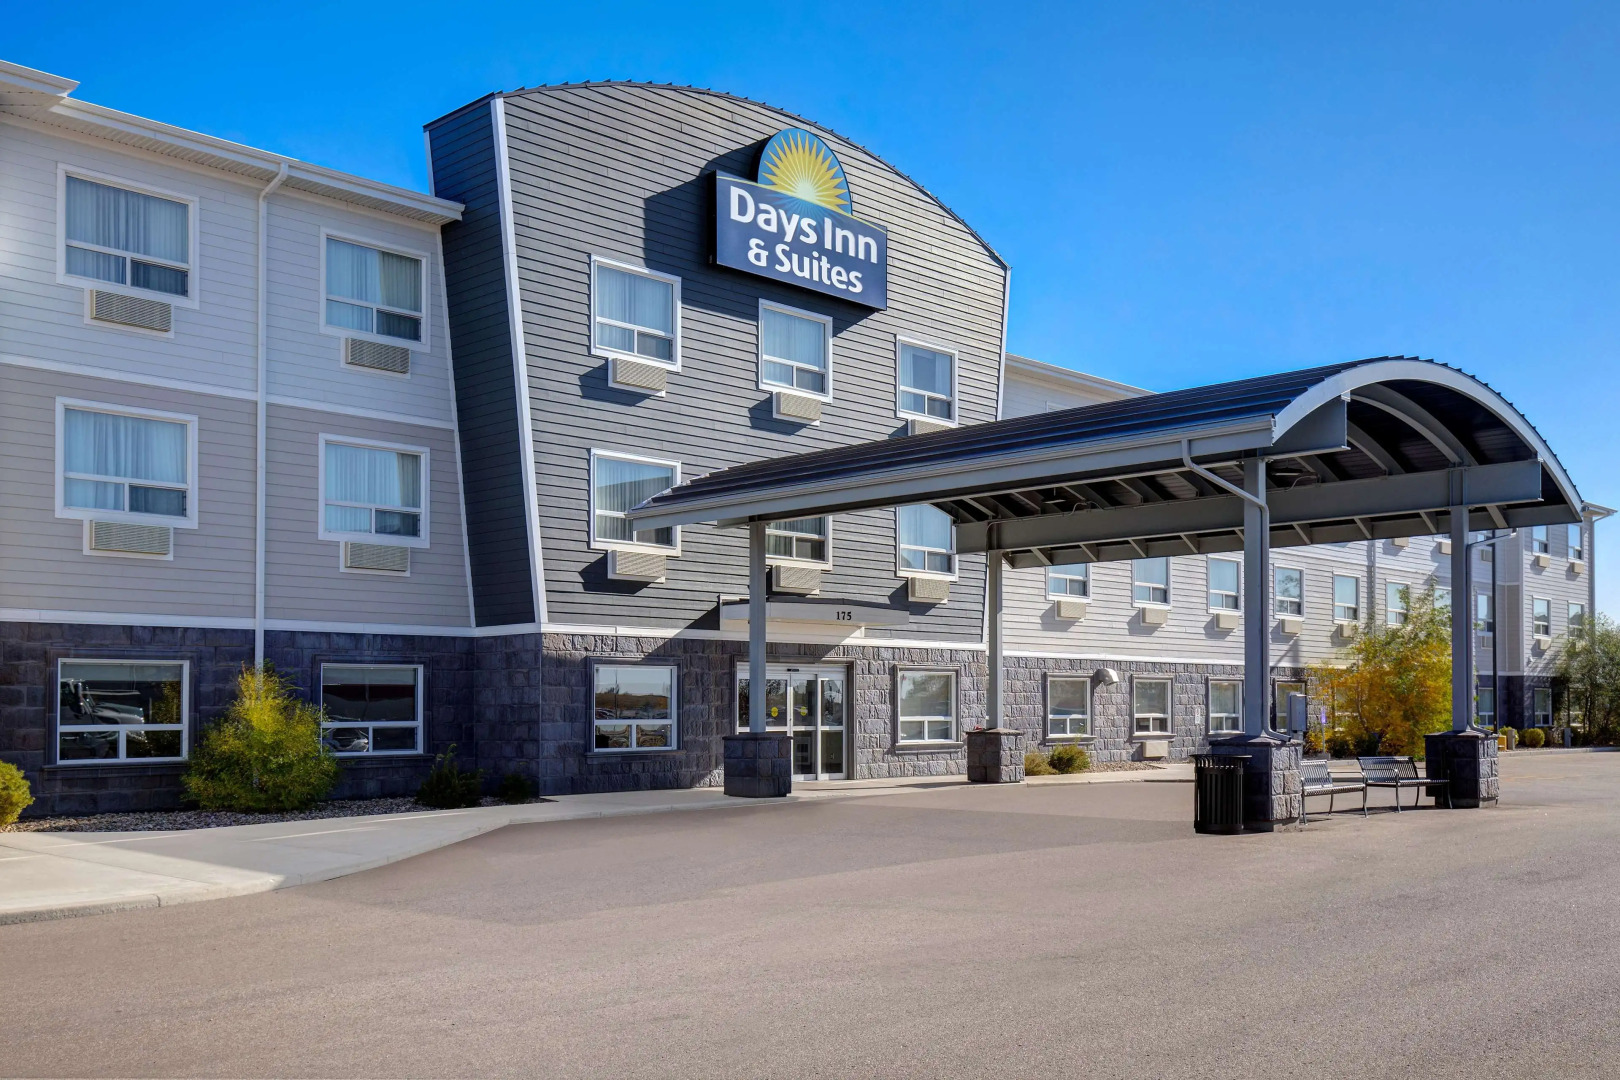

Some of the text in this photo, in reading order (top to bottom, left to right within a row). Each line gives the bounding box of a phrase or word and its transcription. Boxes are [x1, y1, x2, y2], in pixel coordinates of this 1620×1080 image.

[730, 185, 878, 264] Days Inn
[747, 238, 863, 293] & Suites
[836, 611, 852, 621] 175
